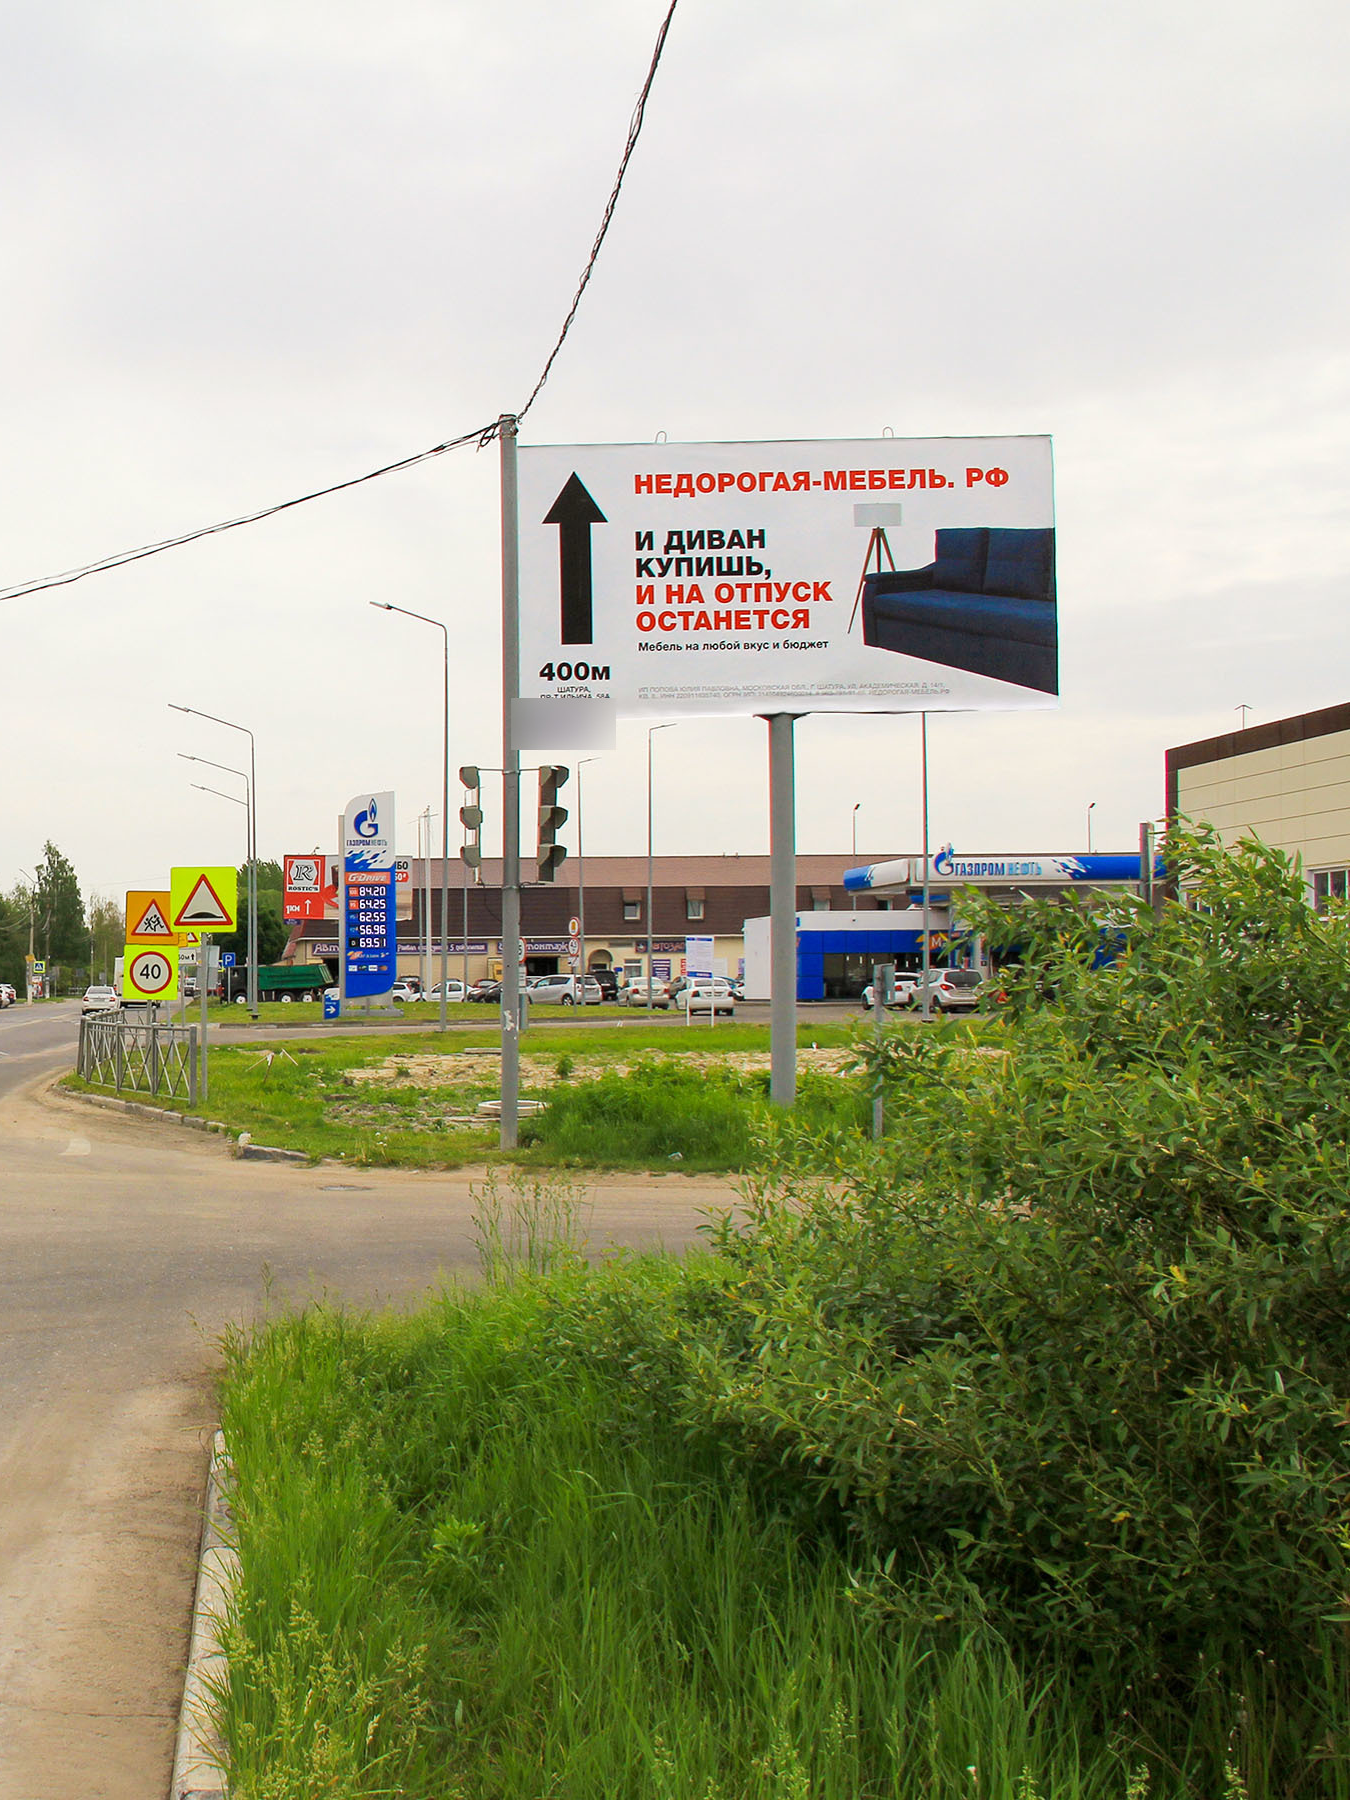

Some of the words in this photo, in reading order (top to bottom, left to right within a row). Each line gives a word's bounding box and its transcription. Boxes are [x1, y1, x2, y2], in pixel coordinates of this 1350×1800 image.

[634, 468, 954, 498] НЕДОРОГАЯ-МЕБЕЛЬ.
[966, 467, 1009, 489] РФ
[635, 531, 654, 551] И
[663, 529, 766, 555] ДИВАН
[635, 556, 772, 581] КУПИШЬ,
[636, 585, 655, 605] И
[665, 584, 705, 605] НА
[714, 581, 833, 604] ОТПУСК
[636, 609, 810, 632] ОСТАНЕТСЯ
[638, 641, 683, 652] Мебель
[685, 643, 699, 651] на
[702, 640, 741, 651] любой
[743, 641, 770, 652] вкус
[772, 641, 780, 650] и
[782, 639, 829, 650] бюджет
[539, 662, 610, 681] 400м
[359, 886, 386, 897] 84.20
[359, 899, 386, 909] 64.25
[359, 912, 386, 922] 62.55
[359, 925, 386, 935] 56.96
[359, 938, 386, 948] 69.51
[139, 964, 162, 980] 40
